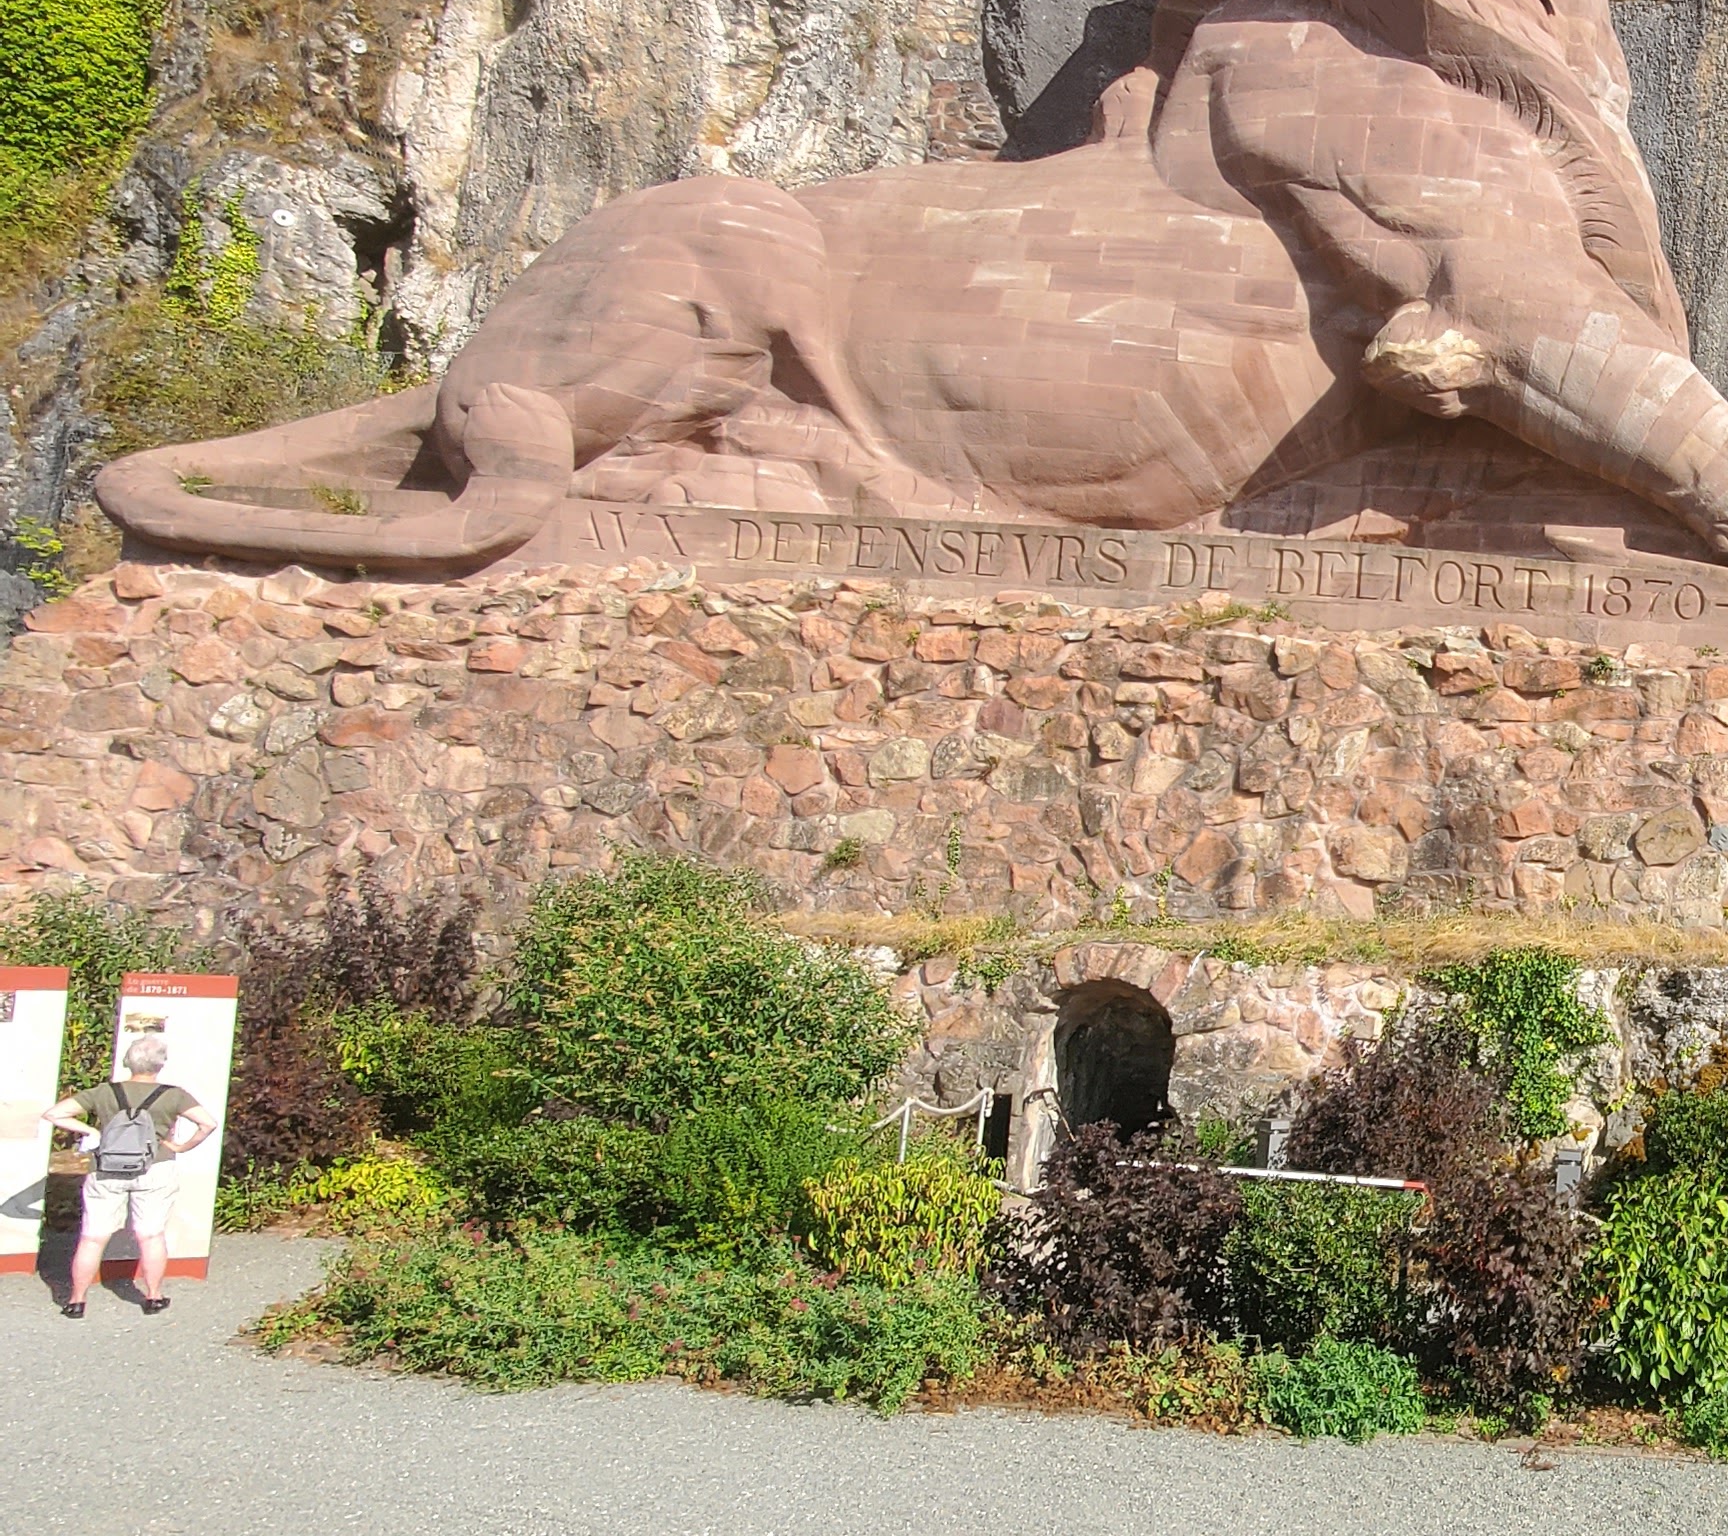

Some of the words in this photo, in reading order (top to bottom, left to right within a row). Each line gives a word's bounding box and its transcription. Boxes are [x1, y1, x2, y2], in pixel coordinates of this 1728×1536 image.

[725, 517, 1129, 584] DEFENSEVRS
[1159, 541, 1237, 591] DE
[1268, 547, 1552, 612] BELFORT
